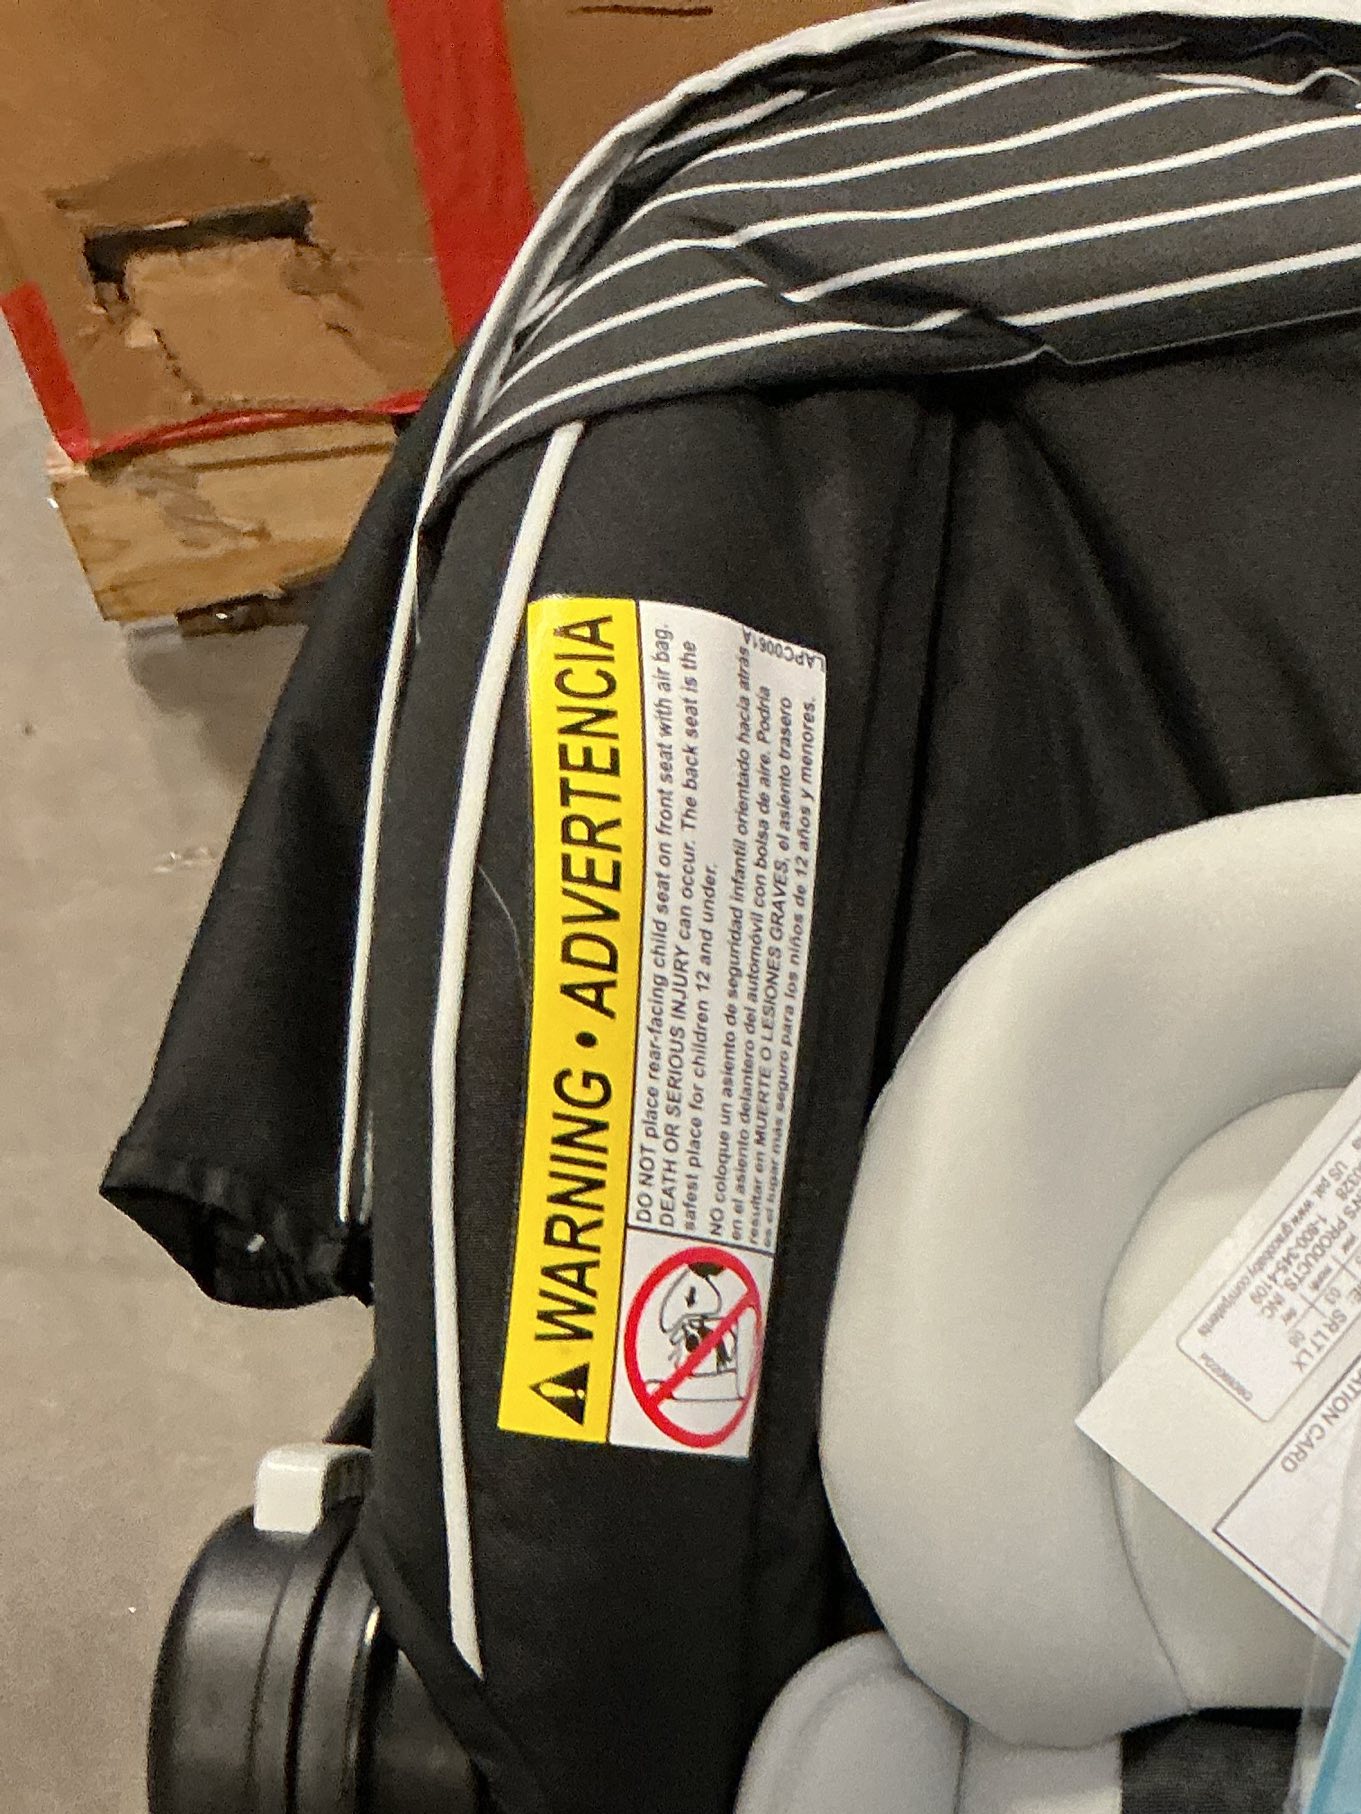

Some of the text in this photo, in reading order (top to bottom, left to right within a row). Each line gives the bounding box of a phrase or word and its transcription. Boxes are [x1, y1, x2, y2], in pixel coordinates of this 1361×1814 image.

[734, 694, 752, 746] hacia
[776, 695, 793, 761] trasero
[733, 746, 751, 836] orientado
[754, 790, 771, 815] de
[775, 763, 792, 834] asiento
[728, 837, 748, 904] infantil
[751, 817, 770, 871] bolsa
[774, 832, 790, 852] el
[634, 623, 674, 1224] DO NOT place rear-facing child seat on front seat with air bag.
[752, 872, 767, 909] con
[657, 639, 699, 1228] DEATH OR SERIOUS INJURY can occur. The back seat is the
[725, 904, 744, 999] seguridad
[533, 615, 623, 1342] WARNING ADVERTENCIA
[759, 944, 782, 1043] LESIONES
[680, 863, 718, 1231] safest place for children 12 and under.
[722, 1002, 738, 1027] de
[742, 1004, 757, 1035] del
[719, 1029, 737, 1099] asiento
[736, 1038, 755, 1125] delantero
[758, 1045, 772, 1062] O
[719, 1101, 733, 1126] un
[752, 1065, 772, 1147] MUERTE
[712, 1129, 732, 1204] coloque
[733, 1127, 750, 1195] asiento
[707, 1206, 725, 1237] NO
[730, 1197, 745, 1215] el
[730, 1217, 743, 1242] en
[1279, 1421, 1326, 1474] CARD
